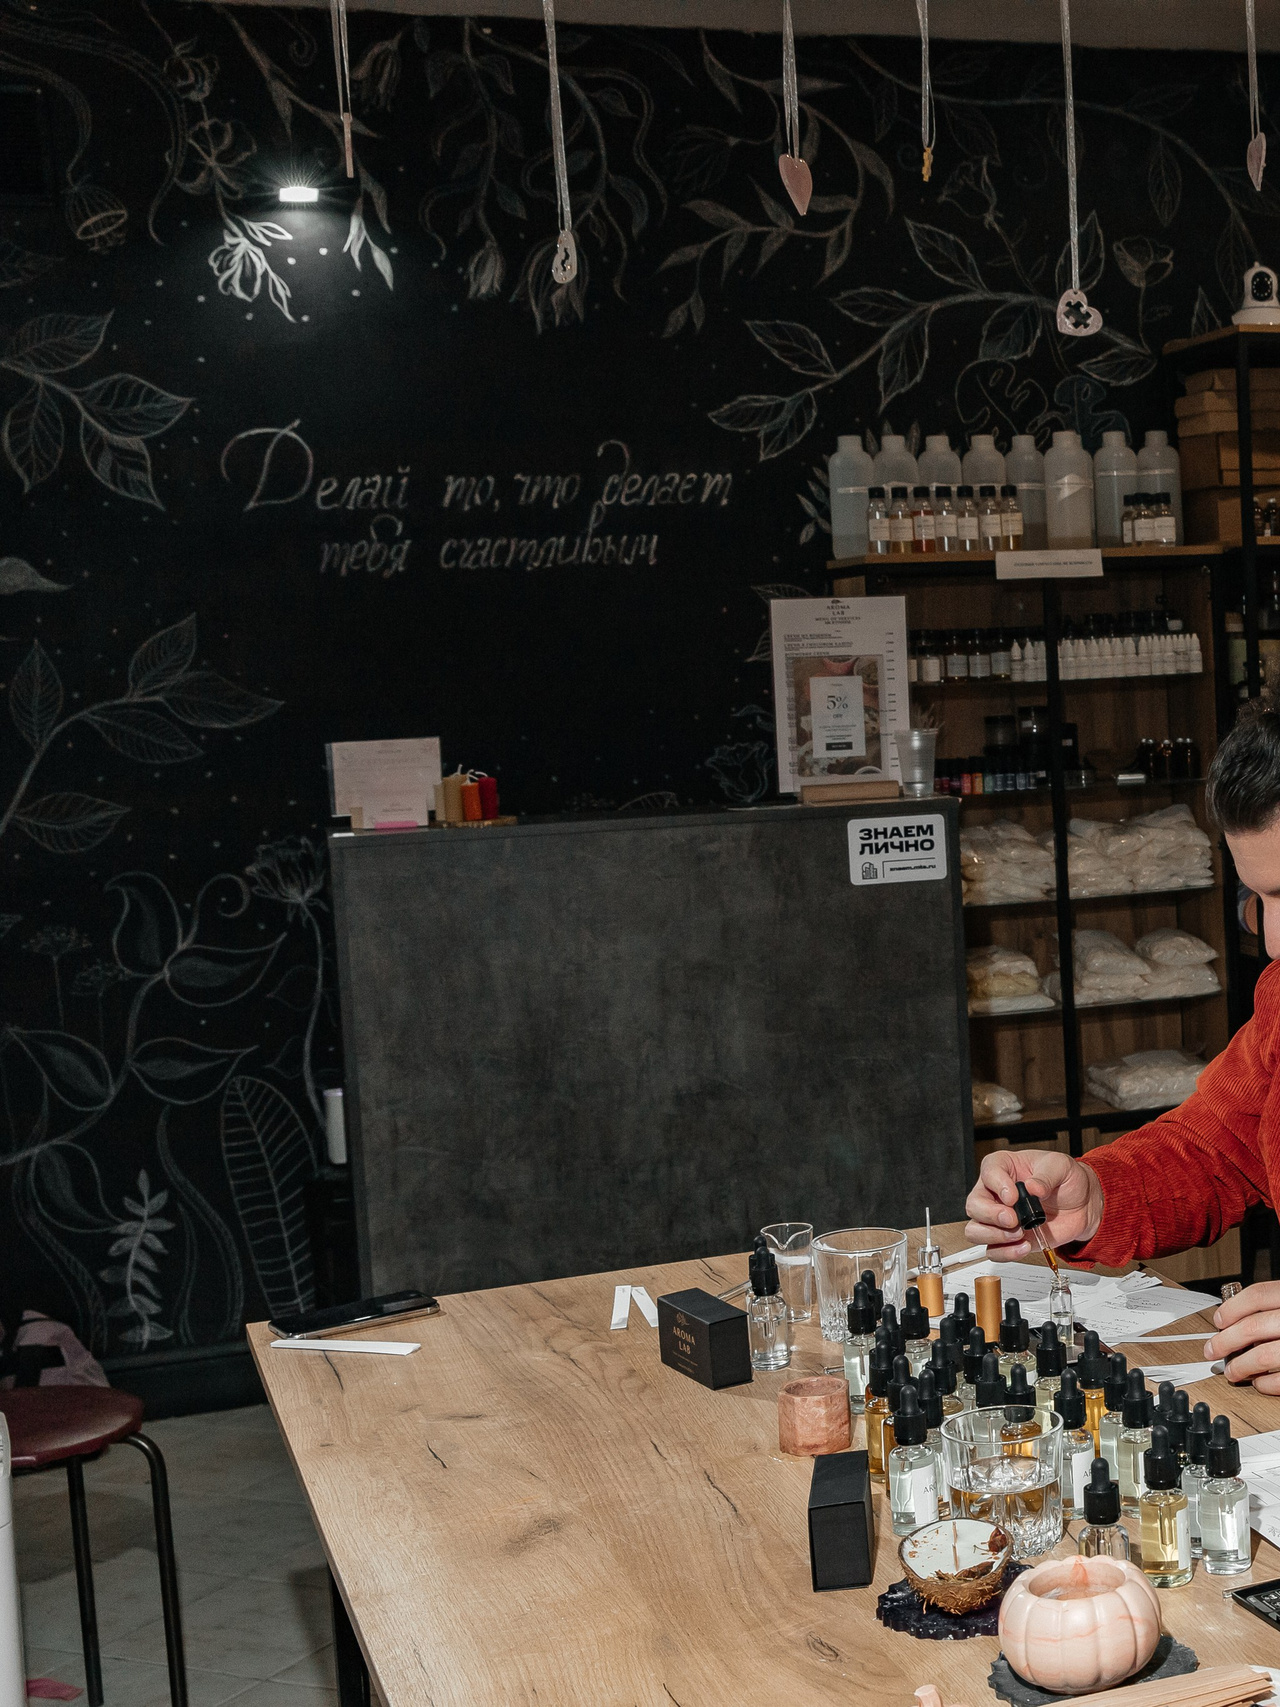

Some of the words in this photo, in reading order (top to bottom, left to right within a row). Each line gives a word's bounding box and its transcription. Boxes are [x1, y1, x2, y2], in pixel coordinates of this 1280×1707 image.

[221, 418, 411, 512] Делай
[514, 471, 581, 511] что
[596, 440, 736, 509] делает
[320, 514, 412, 578] тебя
[440, 501, 659, 572] счастливым
[826, 695, 848, 710] 5%
[859, 824, 934, 840] ЗНАЕМ
[859, 839, 935, 855] ЛИЧНО
[673, 1326, 696, 1346] AROMA
[678, 1341, 691, 1355] LAB
